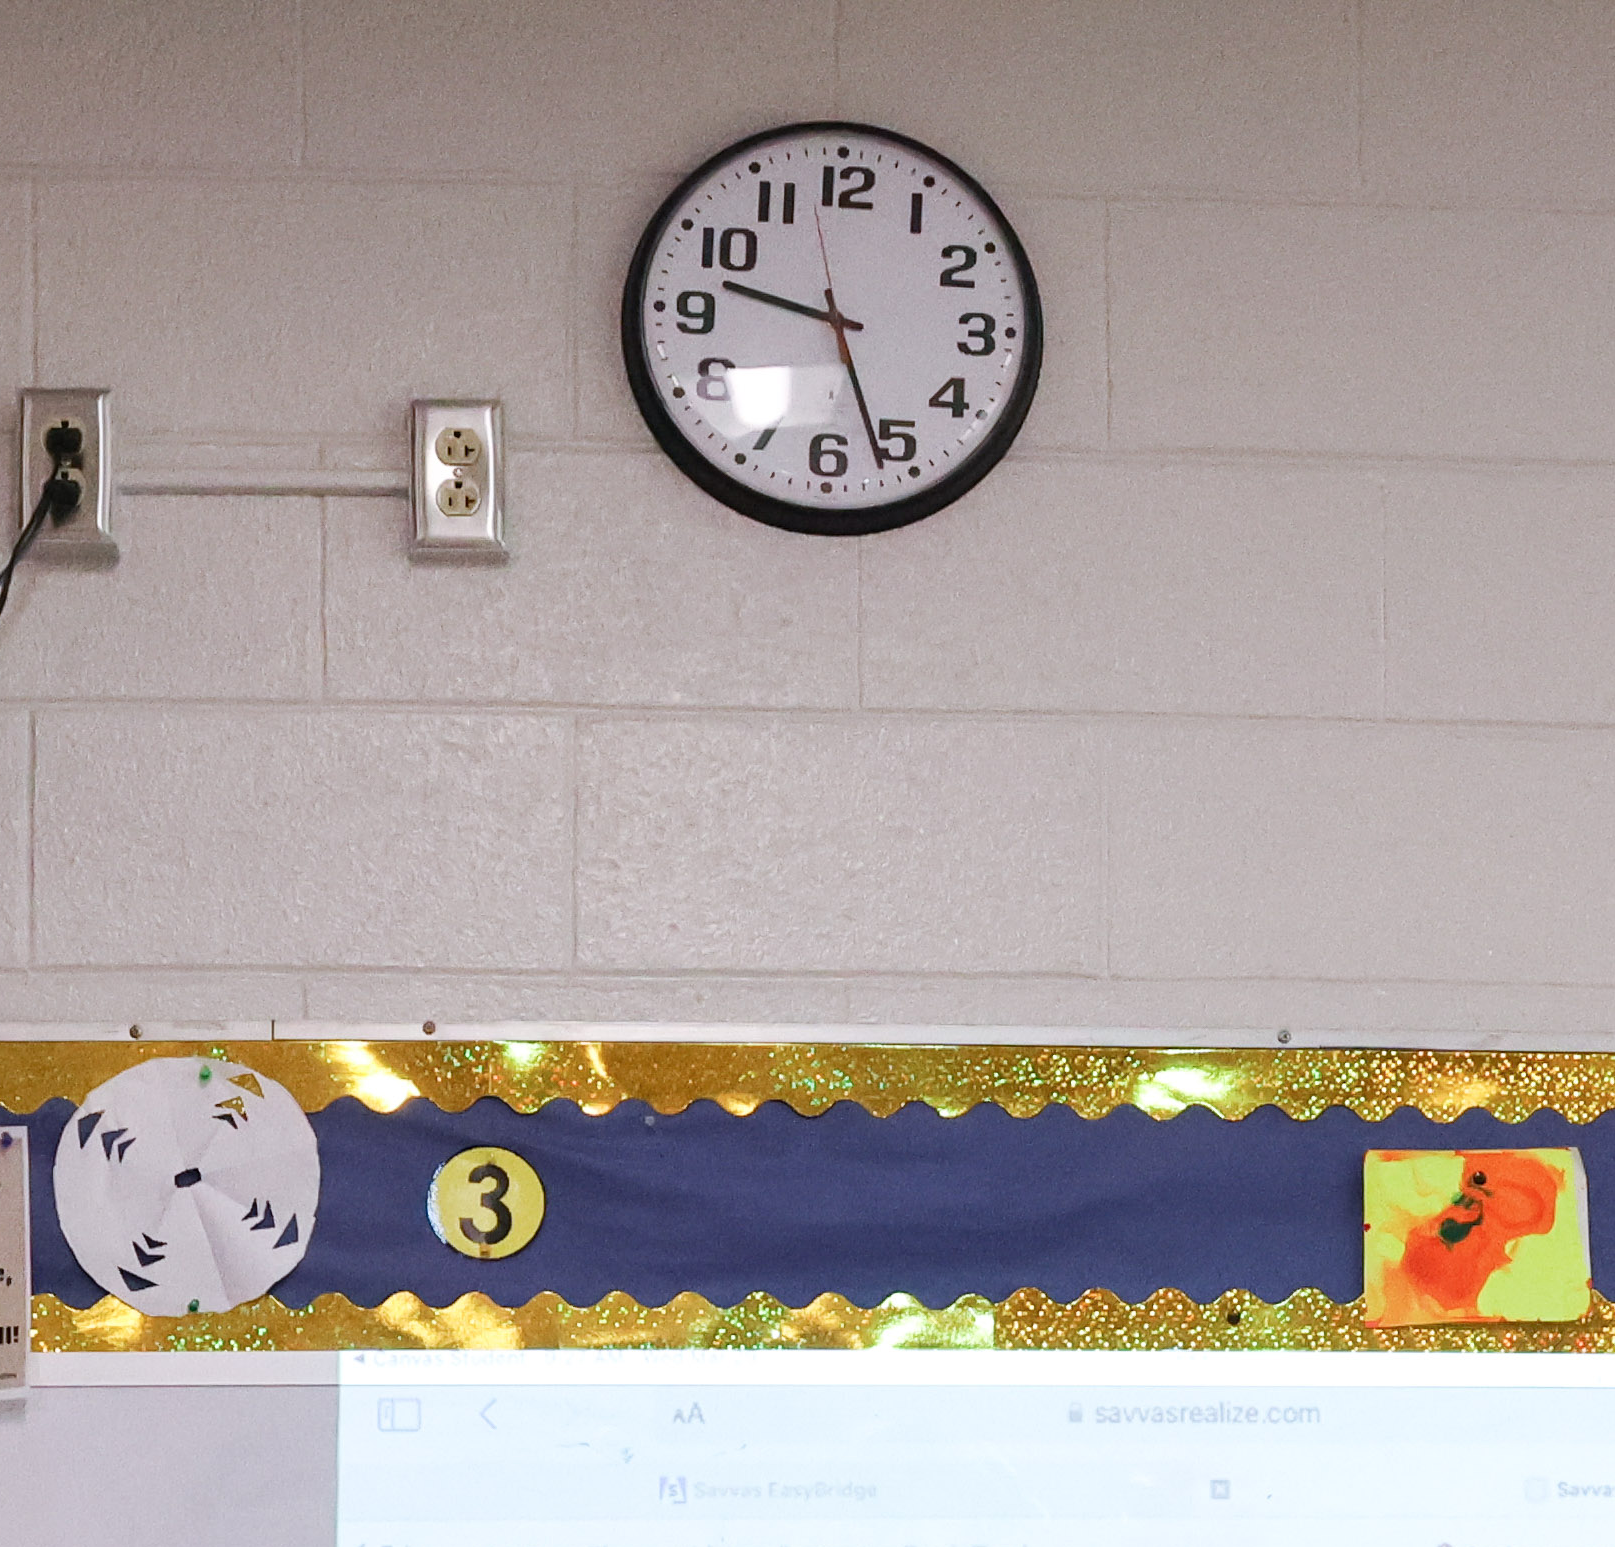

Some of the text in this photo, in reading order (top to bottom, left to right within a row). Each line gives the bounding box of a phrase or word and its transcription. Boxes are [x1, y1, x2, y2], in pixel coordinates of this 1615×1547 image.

[758, 181, 795, 224] 11
[822, 166, 876, 209] 12
[910, 193, 923, 234] 1
[701, 227, 758, 271] 10
[939, 245, 978, 288] 2
[676, 291, 716, 334] 9
[957, 312, 996, 356] 3
[695, 357, 735, 402] 8
[928, 378, 970, 418] 4
[809, 433, 849, 478] 6
[878, 418, 917, 462] 5
[459, 1164, 513, 1248] 3
[1092, 1402, 1322, 1427] savvasrealize.com
[693, 1479, 879, 1504] Savvas EasyBridge
